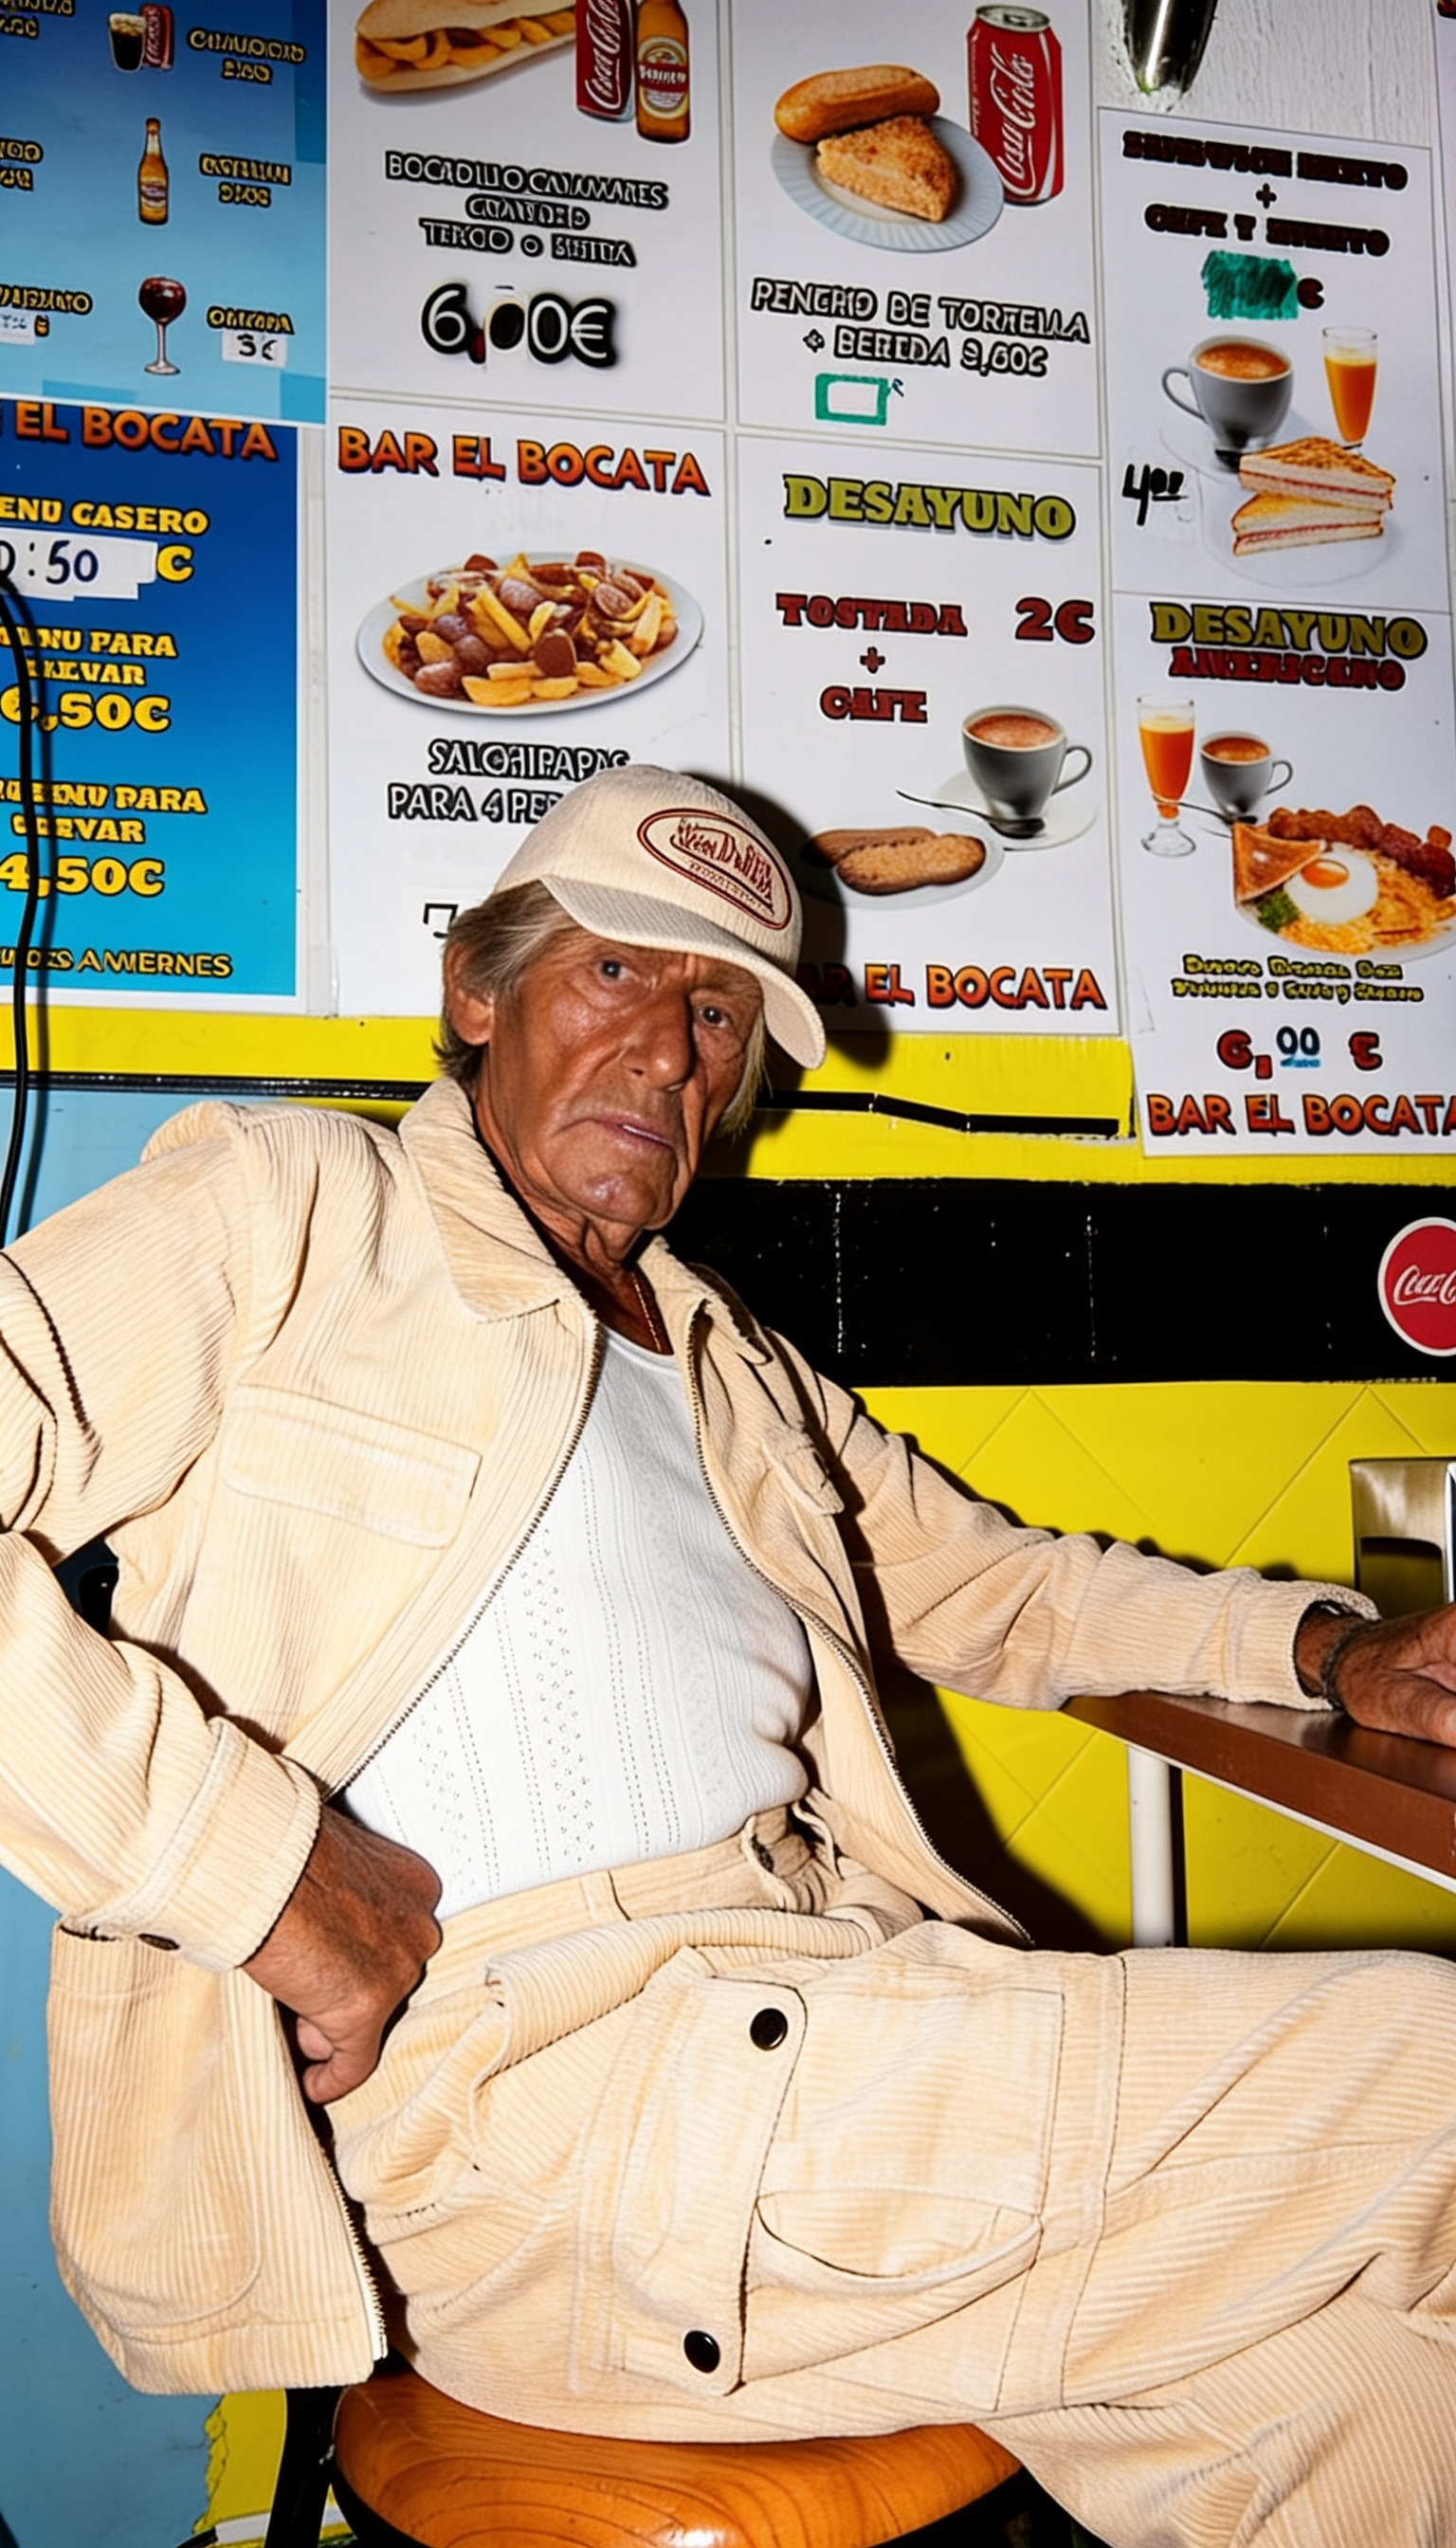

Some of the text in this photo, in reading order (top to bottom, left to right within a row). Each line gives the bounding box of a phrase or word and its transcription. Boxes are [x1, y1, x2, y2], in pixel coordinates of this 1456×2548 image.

[887, 290, 932, 328] DE
[15, 400, 279, 461] EL BOCATA
[337, 426, 712, 497] BAR EL BOCATA
[782, 473, 1076, 539] DESAYUNO
[775, 592, 968, 637] TOSTADA
[1149, 601, 1429, 661] DESAYUNO
[89, 630, 178, 658] PARA
[388, 782, 478, 822] PARA
[864, 962, 915, 1007] EL
[925, 963, 1109, 1010] BOCATA
[1147, 1094, 1237, 1137] BAR
[1245, 1094, 1296, 1137] EL
